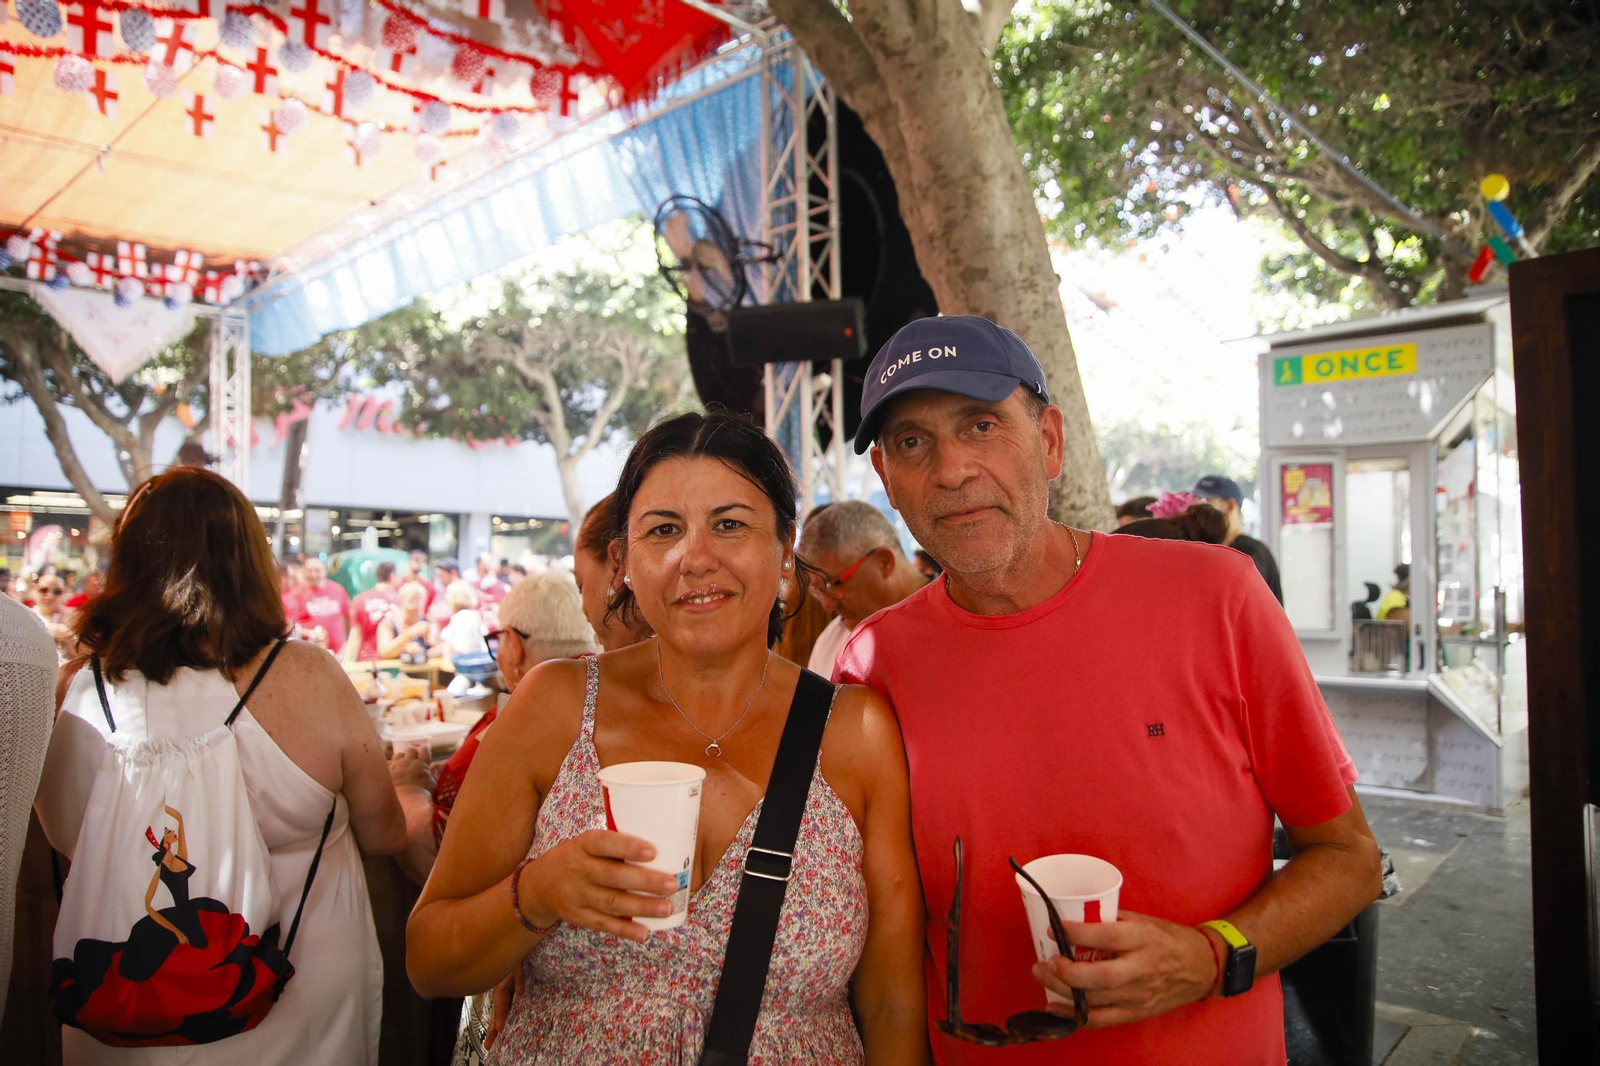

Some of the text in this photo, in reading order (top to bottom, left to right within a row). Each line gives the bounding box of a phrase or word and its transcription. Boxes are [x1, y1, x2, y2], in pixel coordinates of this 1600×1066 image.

[880, 345, 957, 385] COME ON
[1314, 349, 1405, 378] ONCE
